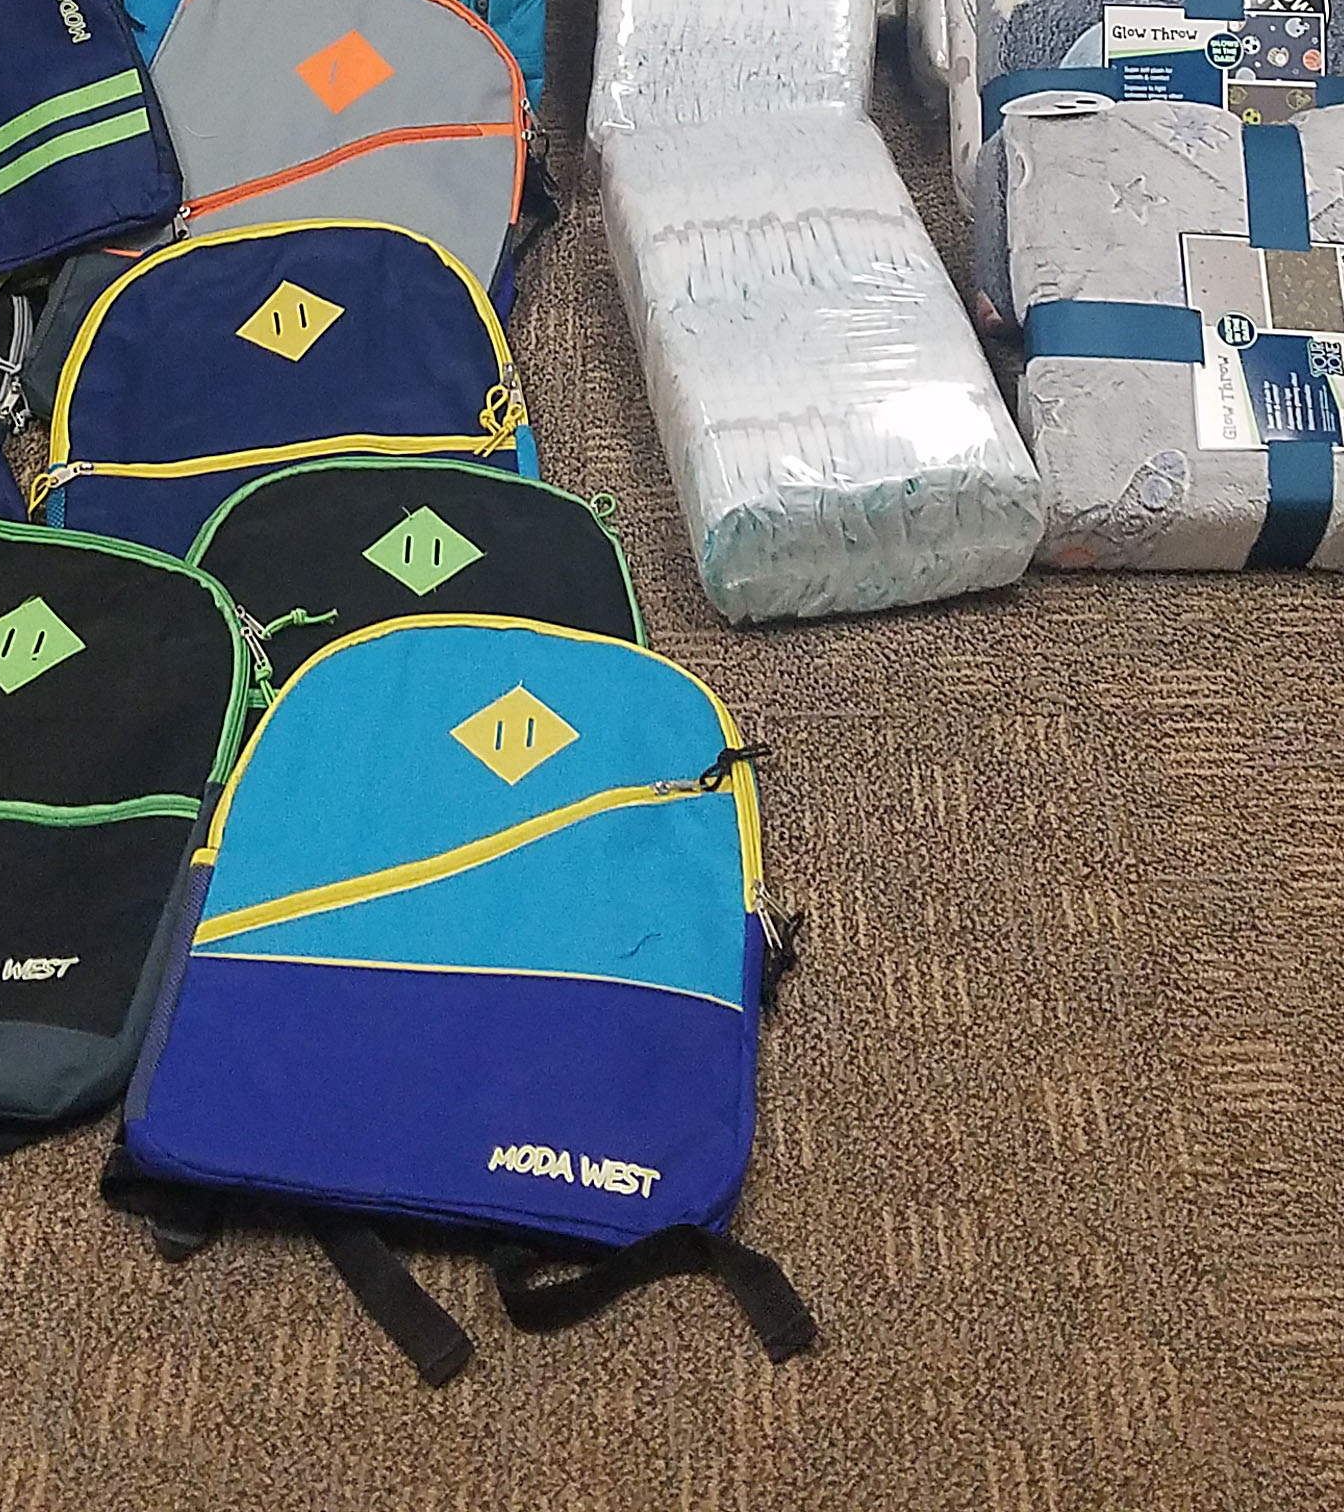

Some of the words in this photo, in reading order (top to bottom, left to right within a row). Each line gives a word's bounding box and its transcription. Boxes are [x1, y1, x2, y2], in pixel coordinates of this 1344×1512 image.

[1112, 25, 1147, 39] Glow
[1151, 26, 1198, 40] Throw
[1310, 340, 1327, 375] YOUR
[1326, 341, 1344, 376] ZONE
[2, 956, 80, 981] WEST
[488, 1144, 575, 1184] MODA
[580, 1153, 661, 1199] WEST
